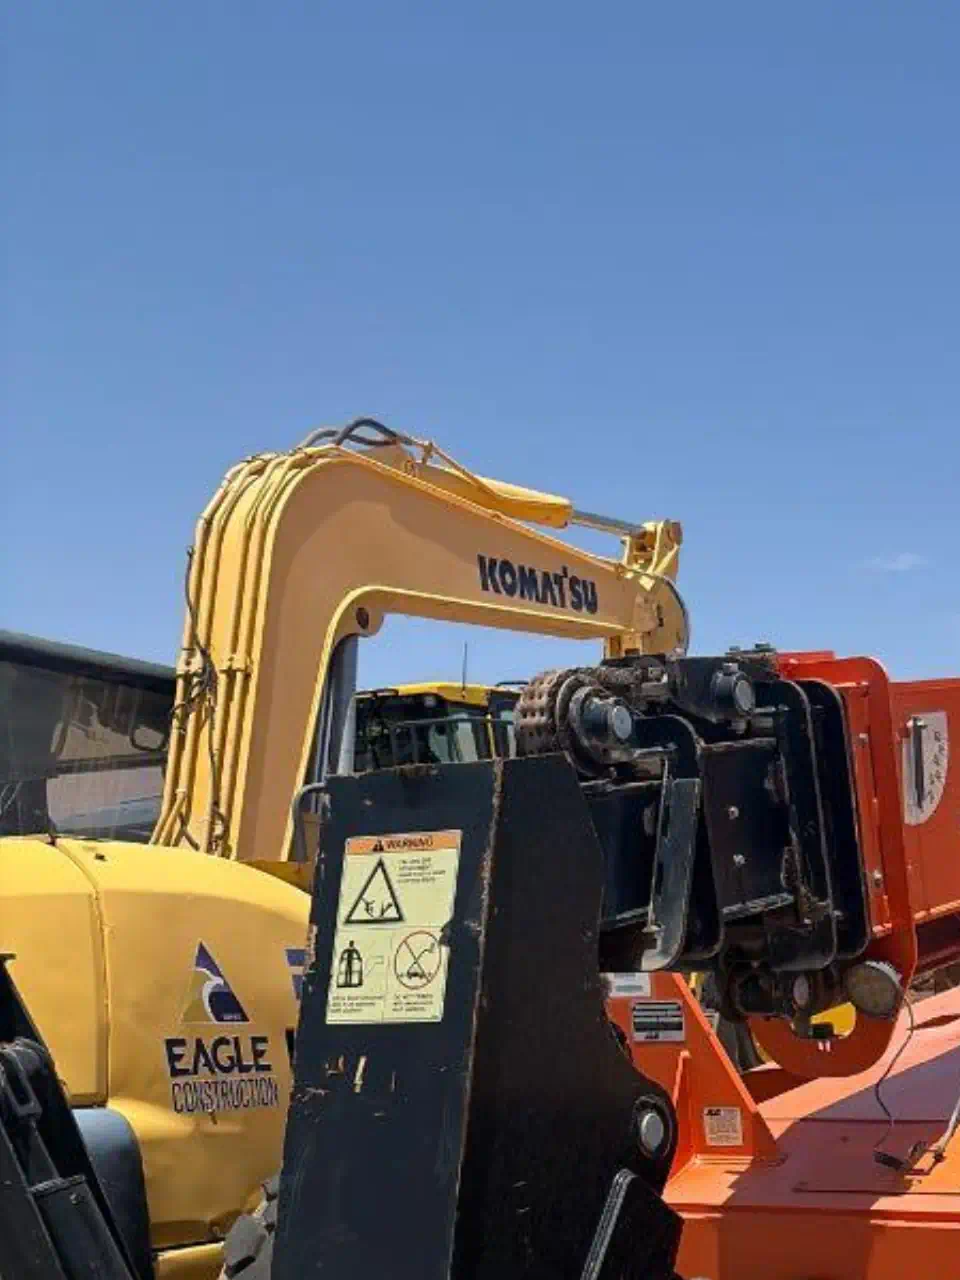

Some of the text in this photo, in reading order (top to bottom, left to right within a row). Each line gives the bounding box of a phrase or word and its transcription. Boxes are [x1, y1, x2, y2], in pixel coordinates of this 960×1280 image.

[477, 554, 598, 614] KOMATSU
[164, 1035, 273, 1077] EAGLE
[171, 1077, 279, 1114] CONSTRUCTION
